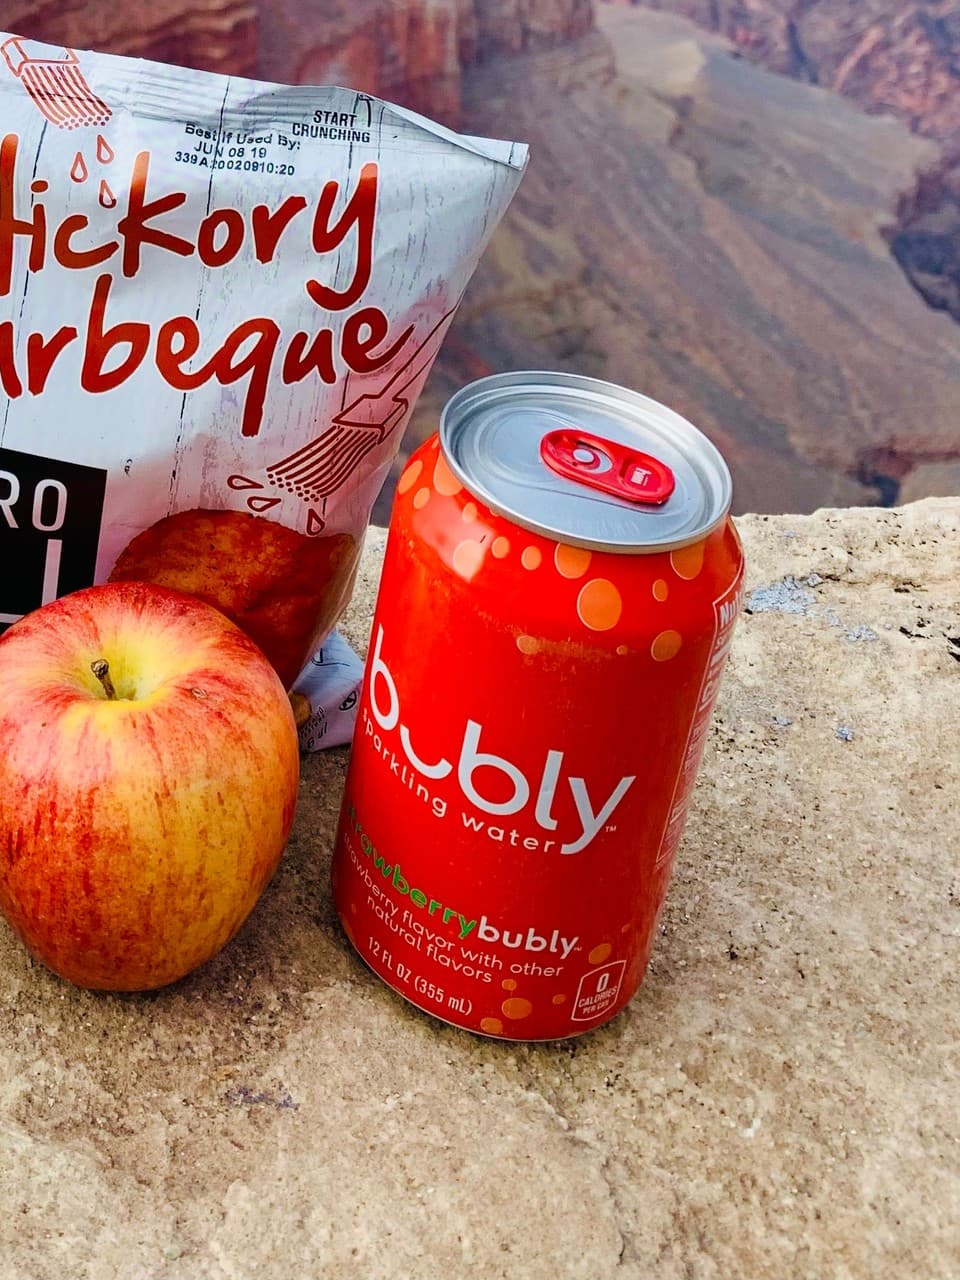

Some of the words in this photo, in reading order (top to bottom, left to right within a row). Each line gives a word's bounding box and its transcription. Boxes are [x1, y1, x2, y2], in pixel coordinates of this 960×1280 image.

[313, 110, 357, 128] START
[185, 123, 217, 141] Best
[222, 131, 231, 144] If
[237, 133, 272, 145] Used
[278, 135, 301, 150] By:
[292, 123, 371, 143] CRUNCHING
[194, 141, 224, 158] JUN
[229, 147, 245, 158] 08
[250, 147, 267, 159] 19
[370, 623, 637, 855] bubly
[461, 811, 556, 853] water
[344, 832, 399, 917] trawberry
[403, 910, 455, 950] flavor
[461, 946, 503, 971] with
[510, 963, 564, 978] other
[367, 896, 422, 952] natural
[426, 943, 493, 984] flavors
[368, 936, 379, 956] 12
[382, 949, 392, 970] FL
[396, 964, 411, 984] OZ
[414, 975, 444, 1003] (355
[447, 996, 473, 1016] mL)
[597, 973, 609, 993] 0
[578, 985, 617, 1008] CALORIES
